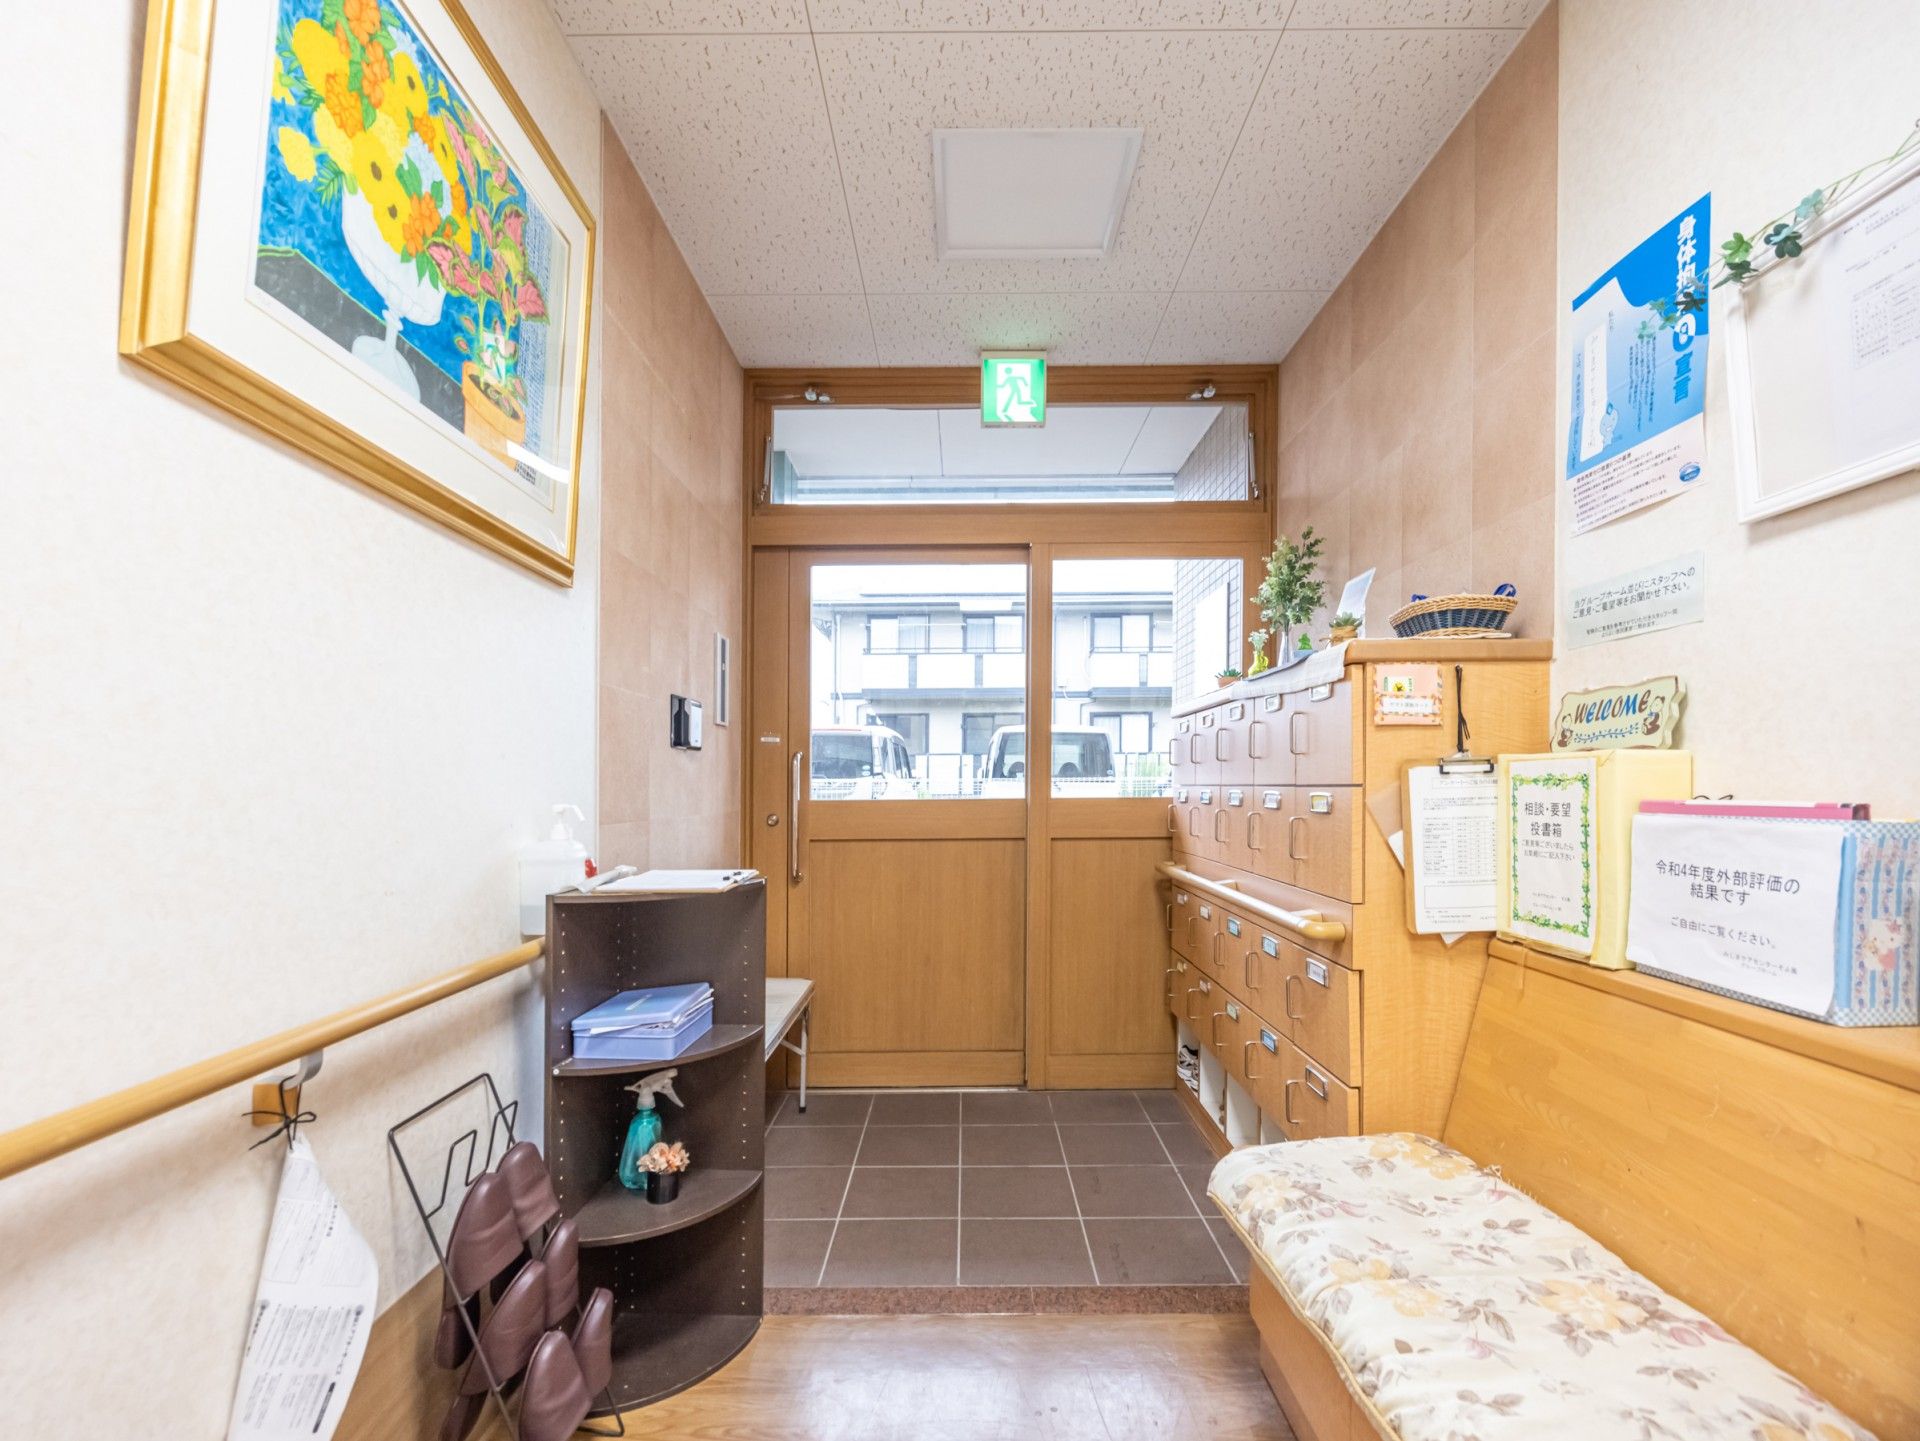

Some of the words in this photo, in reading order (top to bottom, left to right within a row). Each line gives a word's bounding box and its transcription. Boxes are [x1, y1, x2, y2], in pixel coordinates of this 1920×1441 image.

[1575, 690, 1651, 724] WELCOME
[1524, 801, 1572, 817] 相談・要望
[1530, 822, 1562, 838] 投書箱
[1655, 859, 1801, 896] 令和4年度外部評価の
[1690, 882, 1751, 906] 結果です
[1671, 916, 1778, 950] ご自由にご覧ください。
